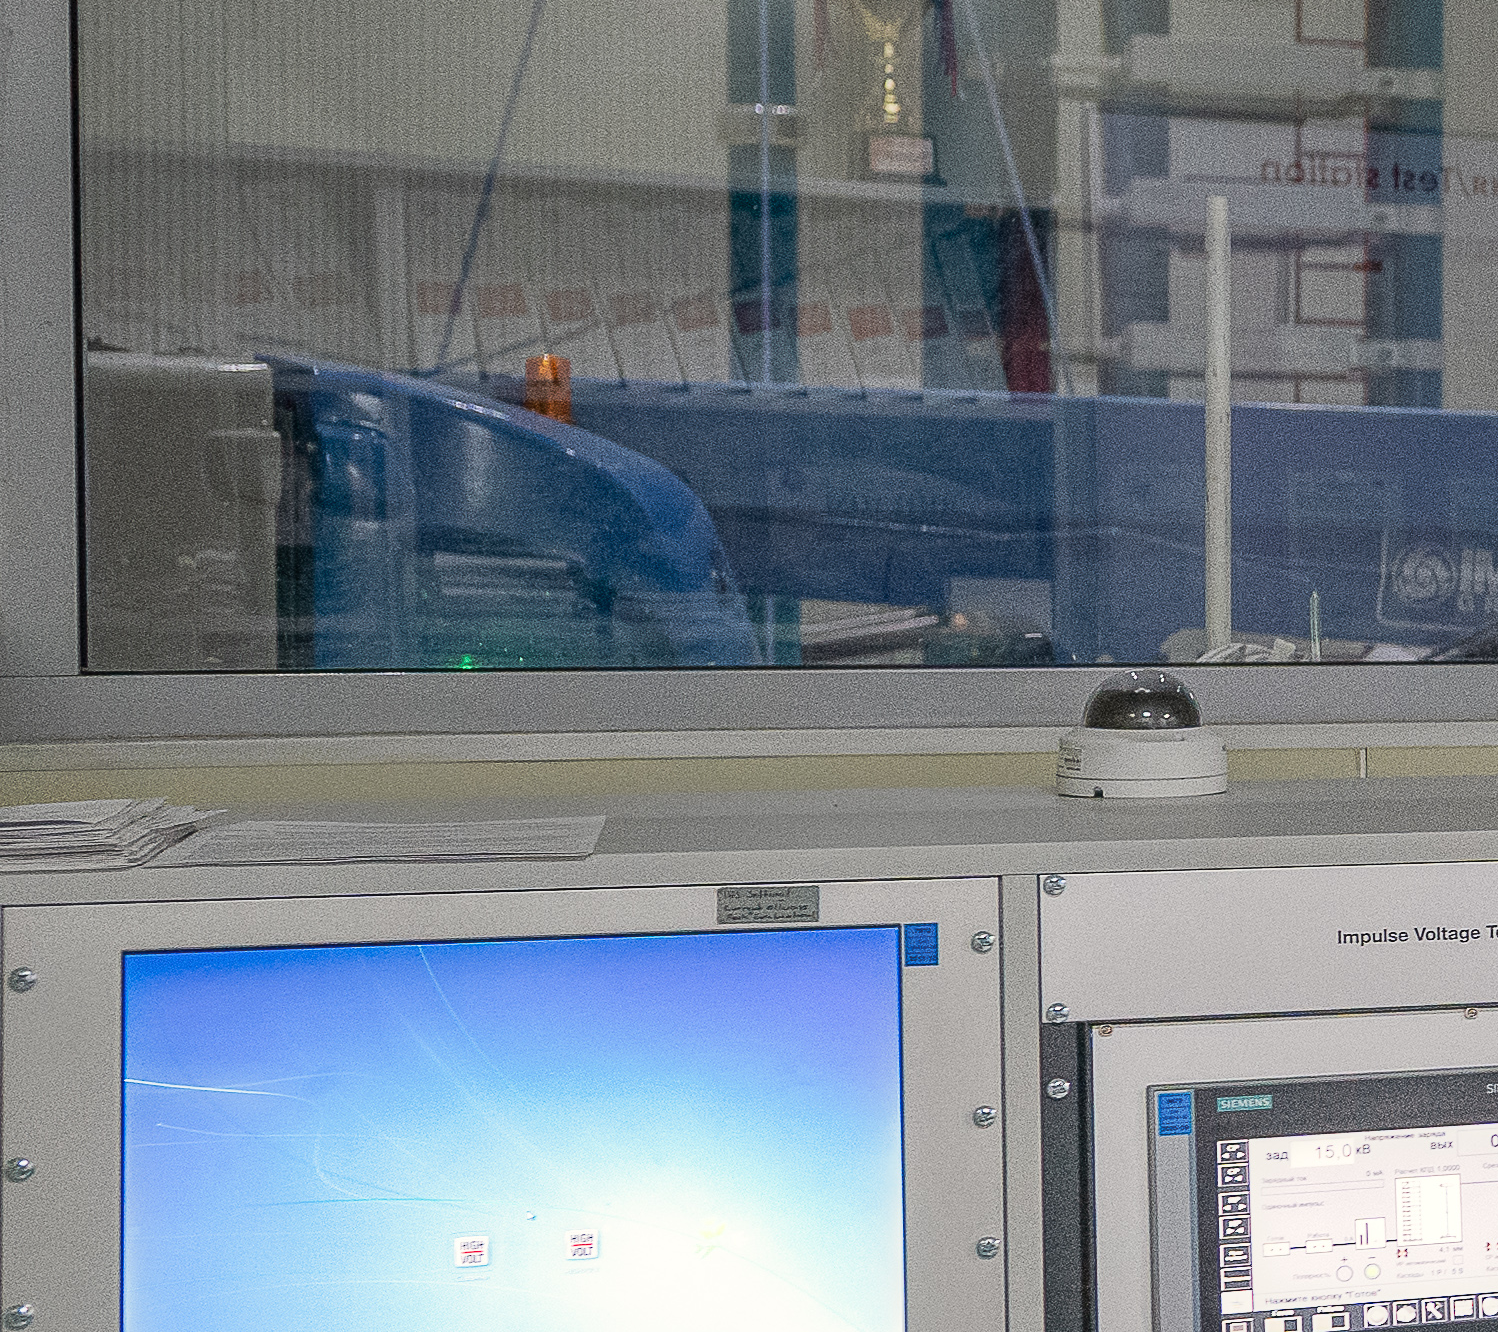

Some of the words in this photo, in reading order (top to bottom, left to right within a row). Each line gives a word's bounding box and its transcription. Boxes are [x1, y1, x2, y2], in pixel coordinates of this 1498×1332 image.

[1337, 929, 1408, 946] Impulse
[1414, 927, 1481, 942] Voltage
[1220, 1098, 1271, 1109] SIEMENS
[1315, 1143, 1352, 1160] 15,0
[1356, 1144, 1372, 1155] кВ
[570, 1234, 594, 1242] HIGH
[461, 1241, 484, 1249] HIGH
[571, 1247, 593, 1257] VOLT
[461, 1254, 484, 1264] VOLT
